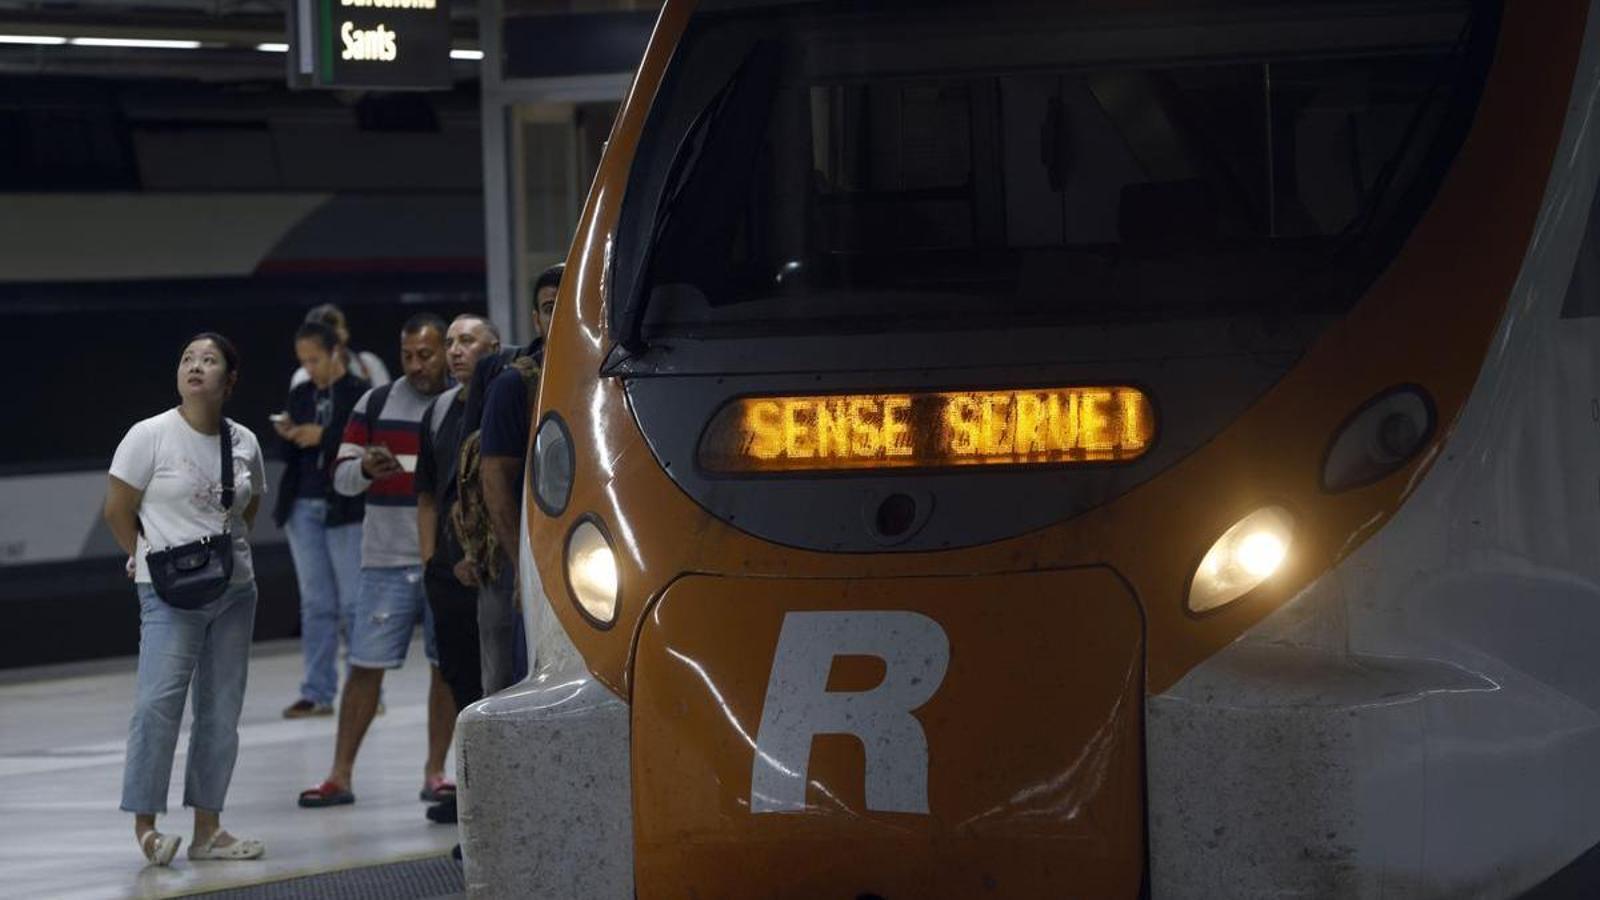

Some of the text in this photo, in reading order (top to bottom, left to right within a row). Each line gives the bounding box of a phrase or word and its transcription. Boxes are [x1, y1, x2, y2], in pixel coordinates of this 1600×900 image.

[340, 20, 398, 61] Sants
[746, 396, 914, 459] SENSE
[751, 610, 950, 814] R
